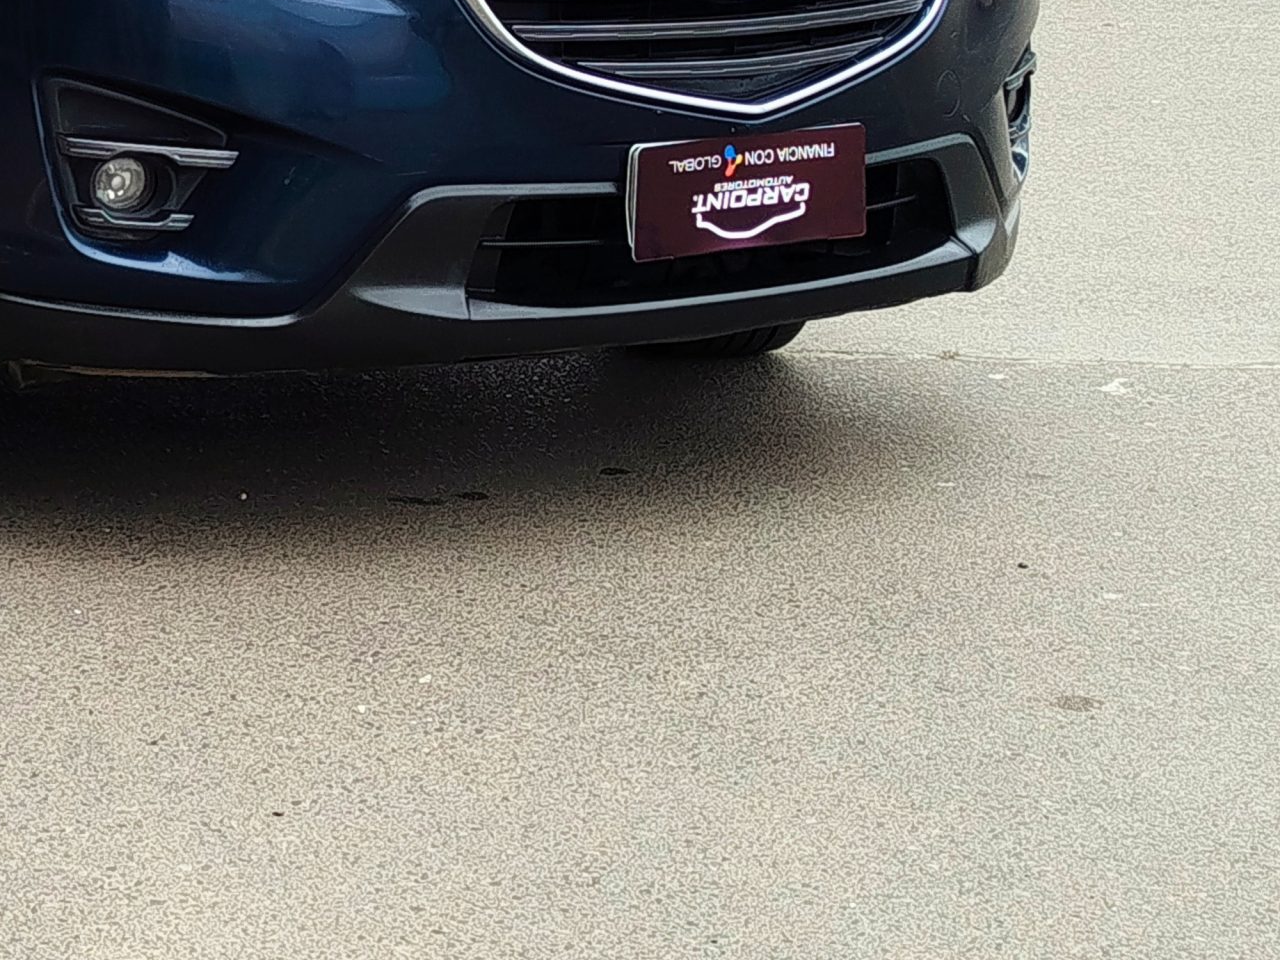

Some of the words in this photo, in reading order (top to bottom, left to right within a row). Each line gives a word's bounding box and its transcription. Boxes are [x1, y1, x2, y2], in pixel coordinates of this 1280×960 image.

[745, 148, 774, 166] CON
[776, 142, 835, 162] FINANCIA
[668, 154, 722, 173] GLOBAL
[714, 176, 794, 192] AUTOMOTORES
